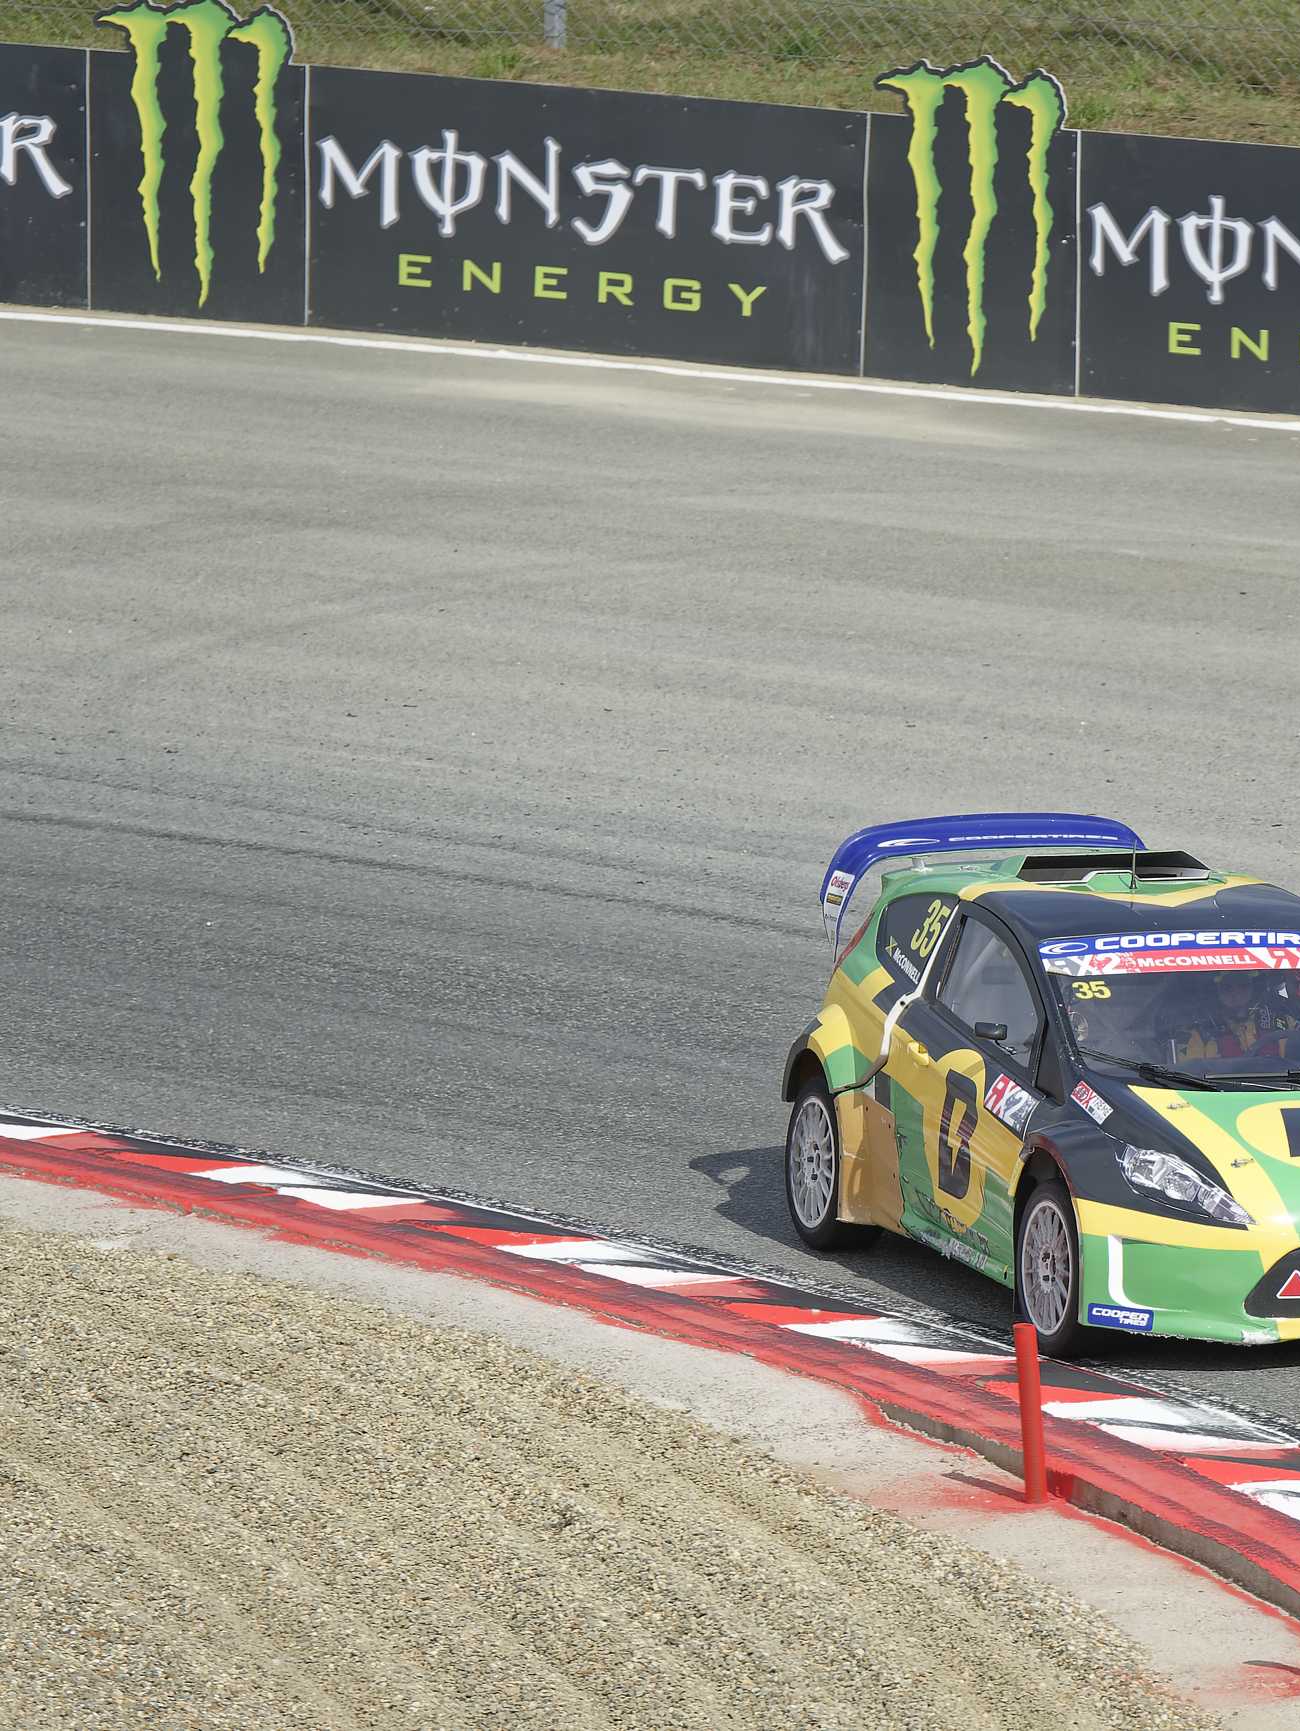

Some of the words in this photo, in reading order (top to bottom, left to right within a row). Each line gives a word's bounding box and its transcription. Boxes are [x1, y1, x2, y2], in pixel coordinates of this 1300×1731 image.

[399, 255, 767, 317] ENERGY
[911, 899, 951, 957] 35
[1137, 954, 1257, 968] McCONNELL
[1071, 981, 1112, 999] 35
[1091, 1307, 1151, 1322] COOPER
[1119, 1317, 1148, 1327] TIRES
